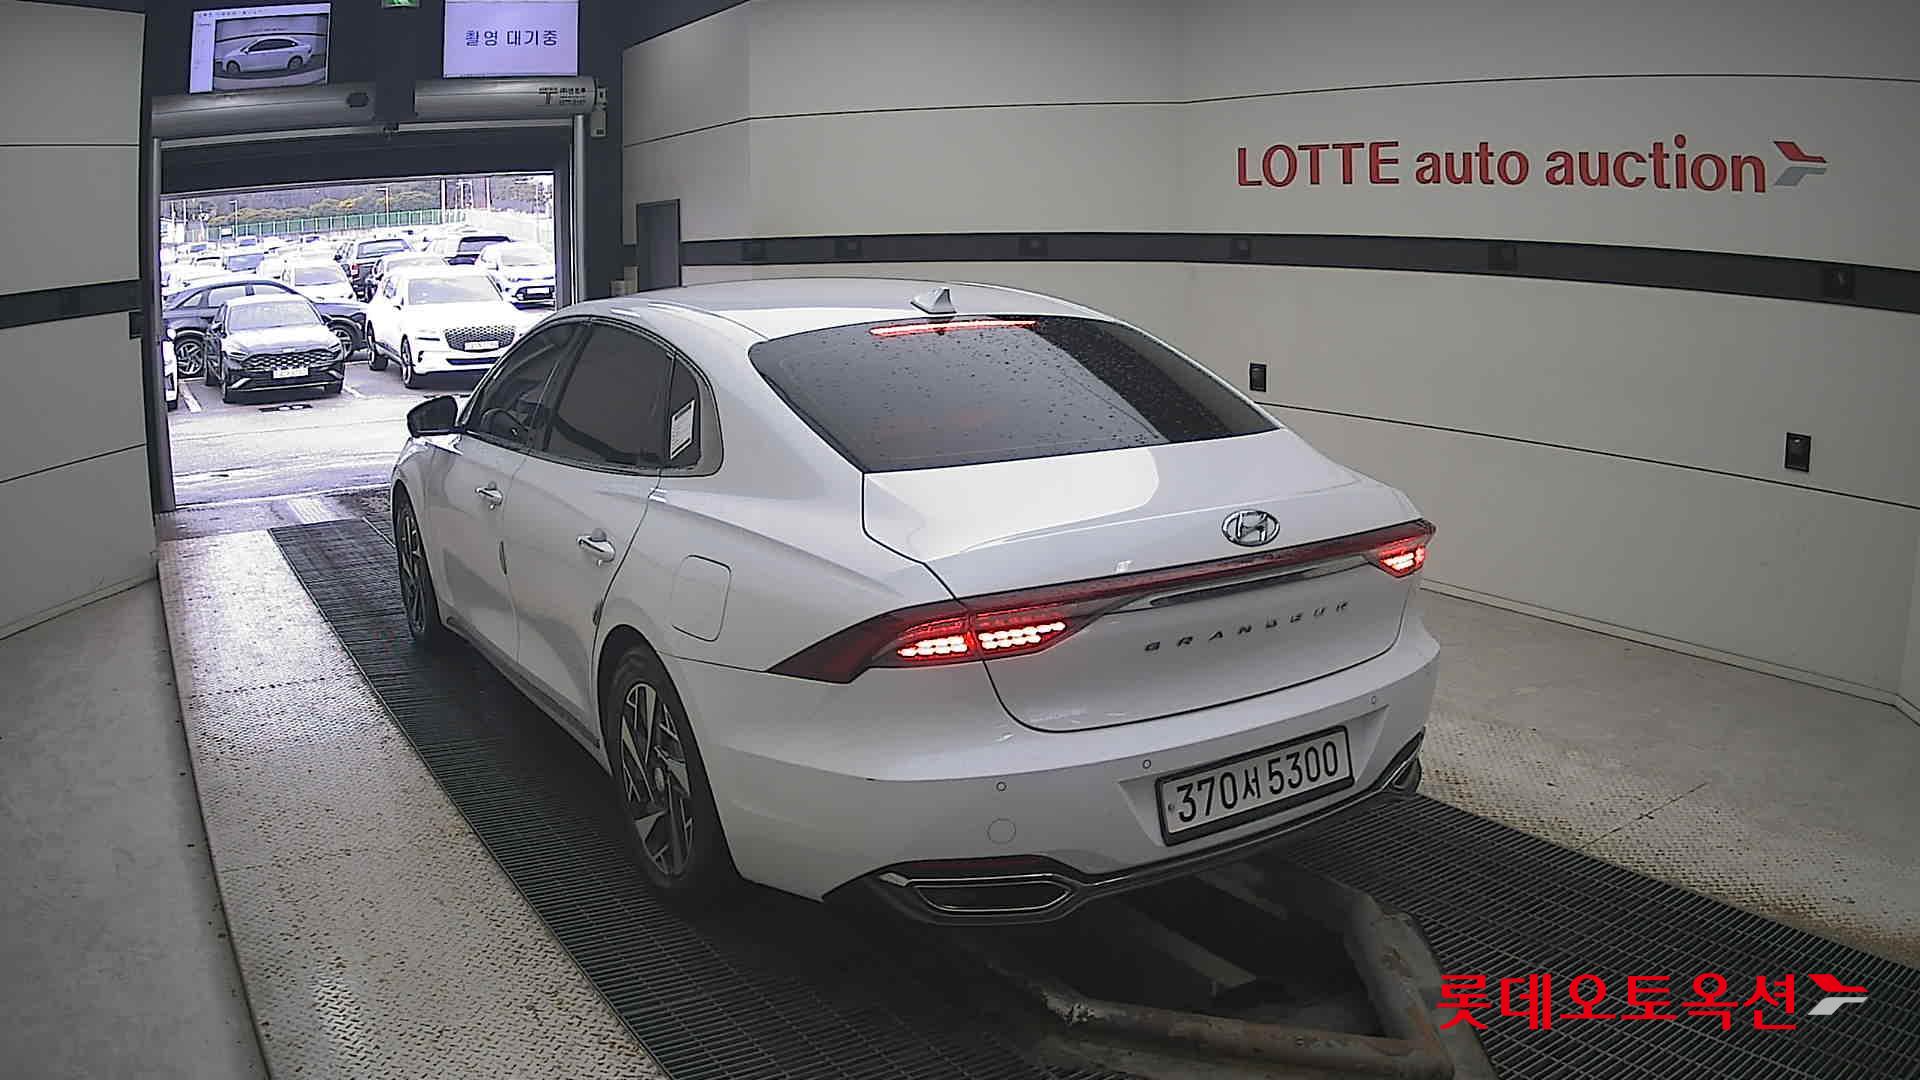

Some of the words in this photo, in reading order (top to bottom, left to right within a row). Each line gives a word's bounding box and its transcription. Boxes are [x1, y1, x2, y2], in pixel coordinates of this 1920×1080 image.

[466, 30, 498, 47] 촬영
[507, 30, 558, 47] 대기중
[1237, 141, 1400, 187] LOTTE
[1415, 142, 1529, 187] auto
[1545, 134, 1767, 193] auction
[1144, 601, 1351, 652] GRANDEUR
